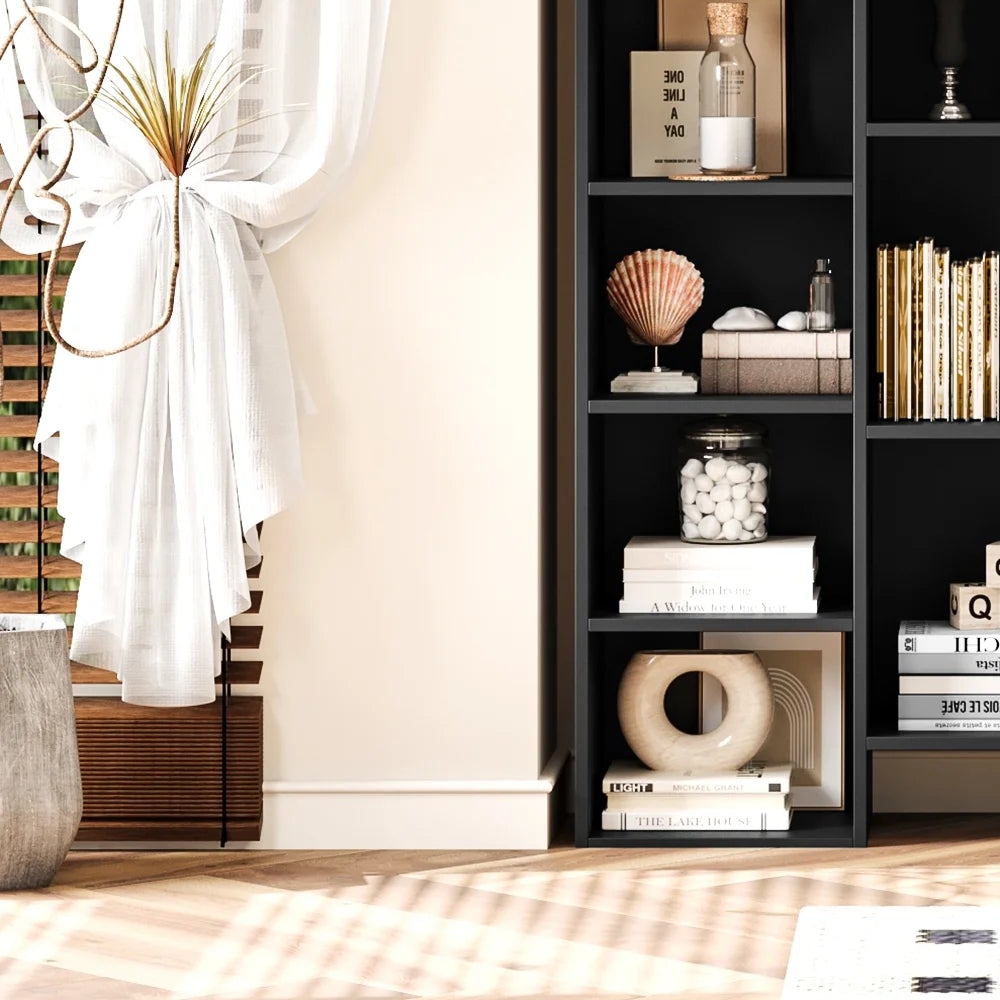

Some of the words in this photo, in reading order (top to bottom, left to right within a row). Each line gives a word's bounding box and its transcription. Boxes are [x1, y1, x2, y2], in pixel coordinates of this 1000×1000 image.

[690, 585, 714, 597] John
[650, 603, 660, 613] A
[664, 602, 705, 613] Widow
[968, 594, 992, 620] Q
[941, 700, 967, 715] CAFÉ
[969, 701, 982, 713] LE
[612, 784, 648, 792] LIGHT
[672, 784, 711, 792] MICHAEL
[713, 784, 744, 792] GRANT
[635, 817, 665, 826] THE
[668, 817, 703, 826] LAKE
[708, 817, 753, 826] HOUSE
